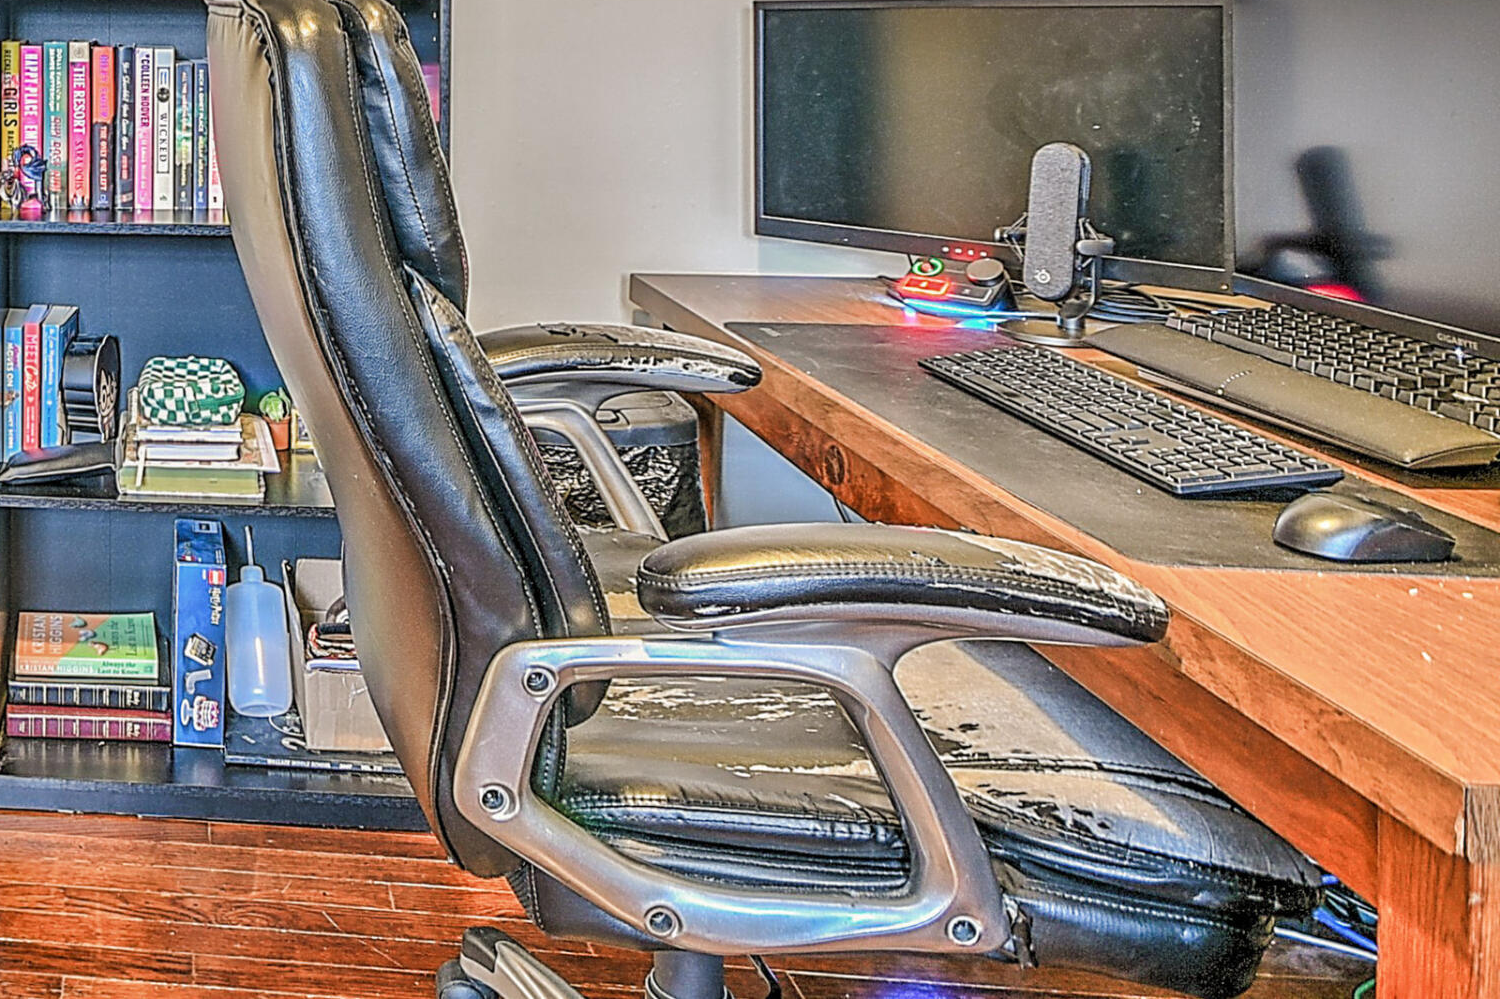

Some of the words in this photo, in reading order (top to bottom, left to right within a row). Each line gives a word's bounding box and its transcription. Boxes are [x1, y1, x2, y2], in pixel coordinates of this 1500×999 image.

[3, 50, 11, 85] RECKLESS
[24, 53, 38, 85] HAPPY
[73, 66, 85, 87] THE
[141, 59, 150, 94] COLLEEN
[4, 87, 17, 127] GIRLS
[24, 87, 38, 116] PLACE
[73, 90, 85, 134] RESORT
[141, 96, 150, 127] HOOVER
[75, 140, 83, 165] SARA
[75, 167, 83, 190] OCHS
[27, 335, 37, 365] MEET
[7, 373, 14, 386] ON
[25, 365, 38, 392] Cute
[32, 615, 46, 654] KRISTAN
[50, 615, 63, 654] HIGGINS
[19, 664, 54, 672] KRISTAN
[57, 665, 93, 673] HIGGINS
[102, 661, 124, 669] Always
